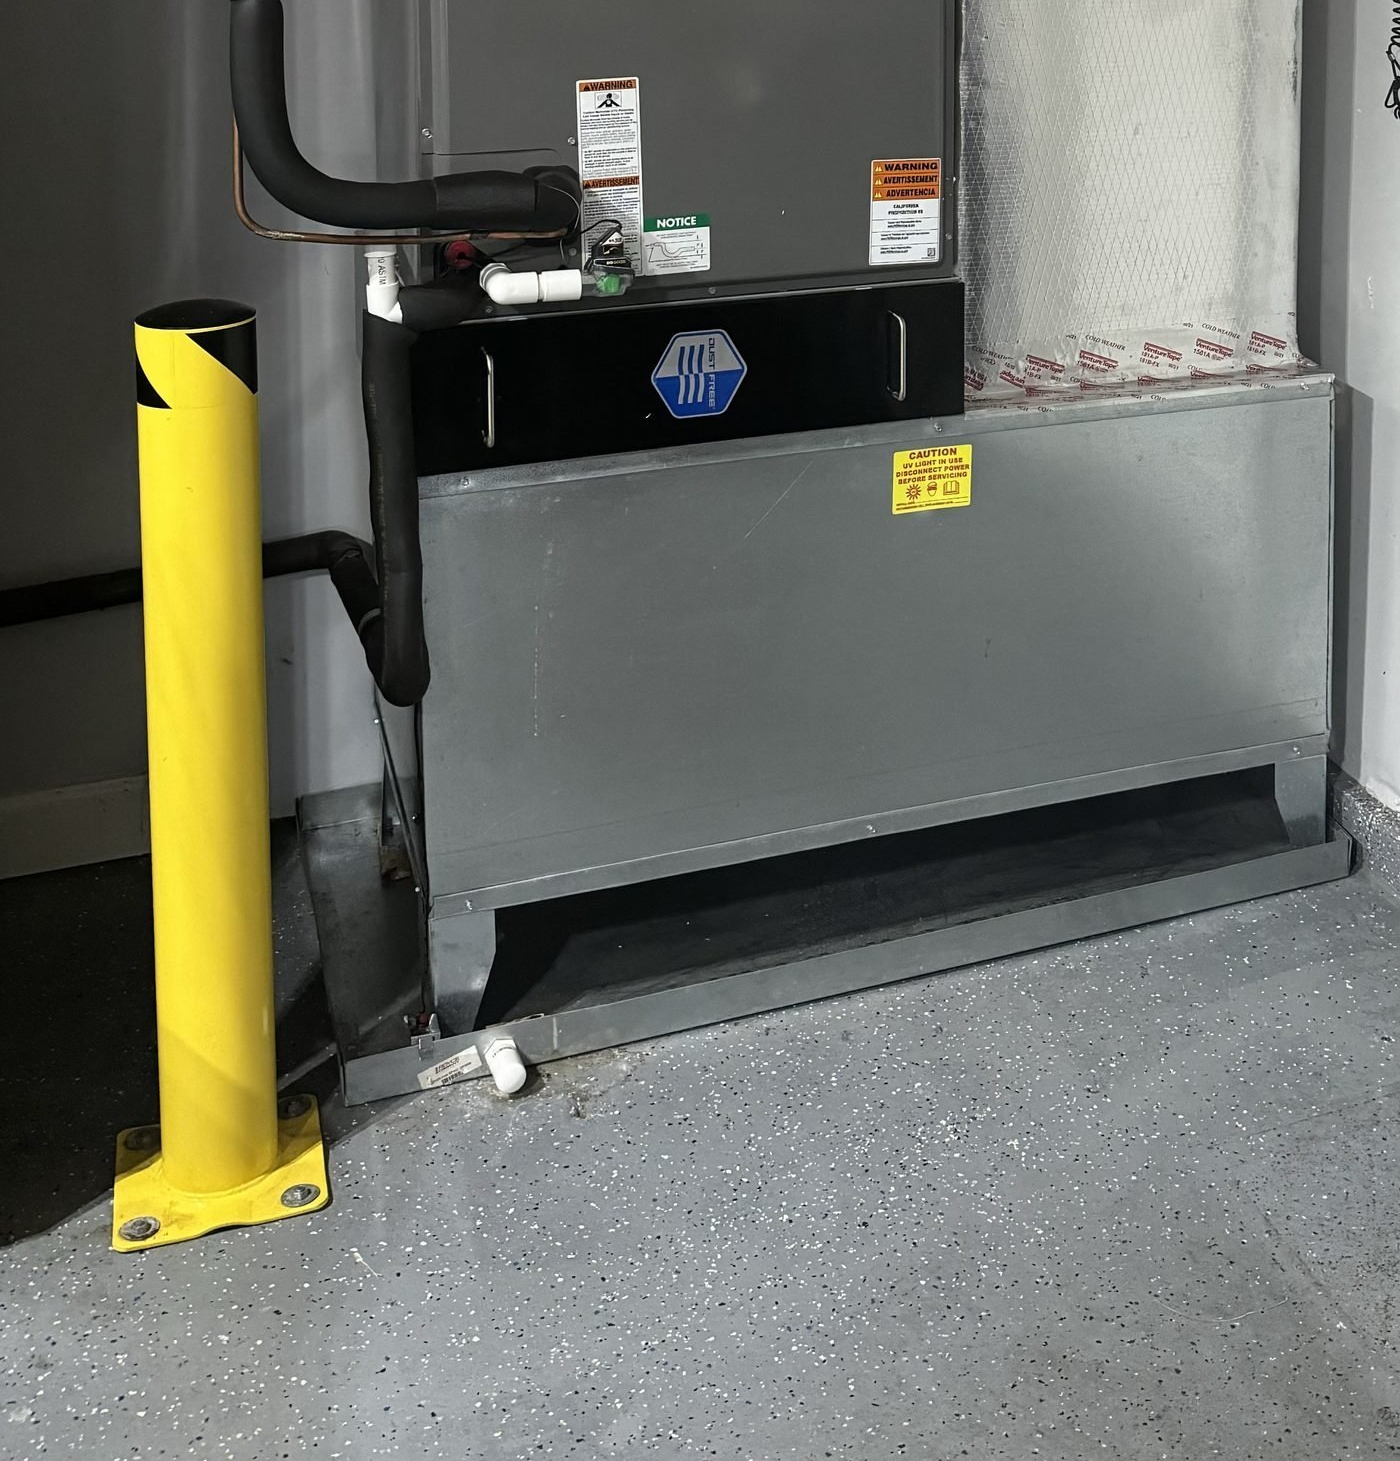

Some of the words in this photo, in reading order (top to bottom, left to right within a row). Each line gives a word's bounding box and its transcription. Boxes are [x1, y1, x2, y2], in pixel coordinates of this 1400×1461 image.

[590, 80, 633, 90] WARNING
[884, 162, 938, 172] WARNING
[592, 177, 640, 188] AVERTISSEMENT
[883, 175, 938, 185] AVERTISSEMENT
[886, 188, 936, 197] ADVERTENCIA
[656, 216, 697, 229] NOTICE
[708, 337, 716, 370] DUST
[708, 374, 716, 408] FREE
[909, 447, 957, 460] CAUTION
[915, 459, 936, 468] LIGHT
[896, 466, 942, 477] DISCONNECT
[944, 464, 970, 472] POWER
[898, 475, 926, 485] BEFORE
[928, 471, 968, 481] SERVICING
